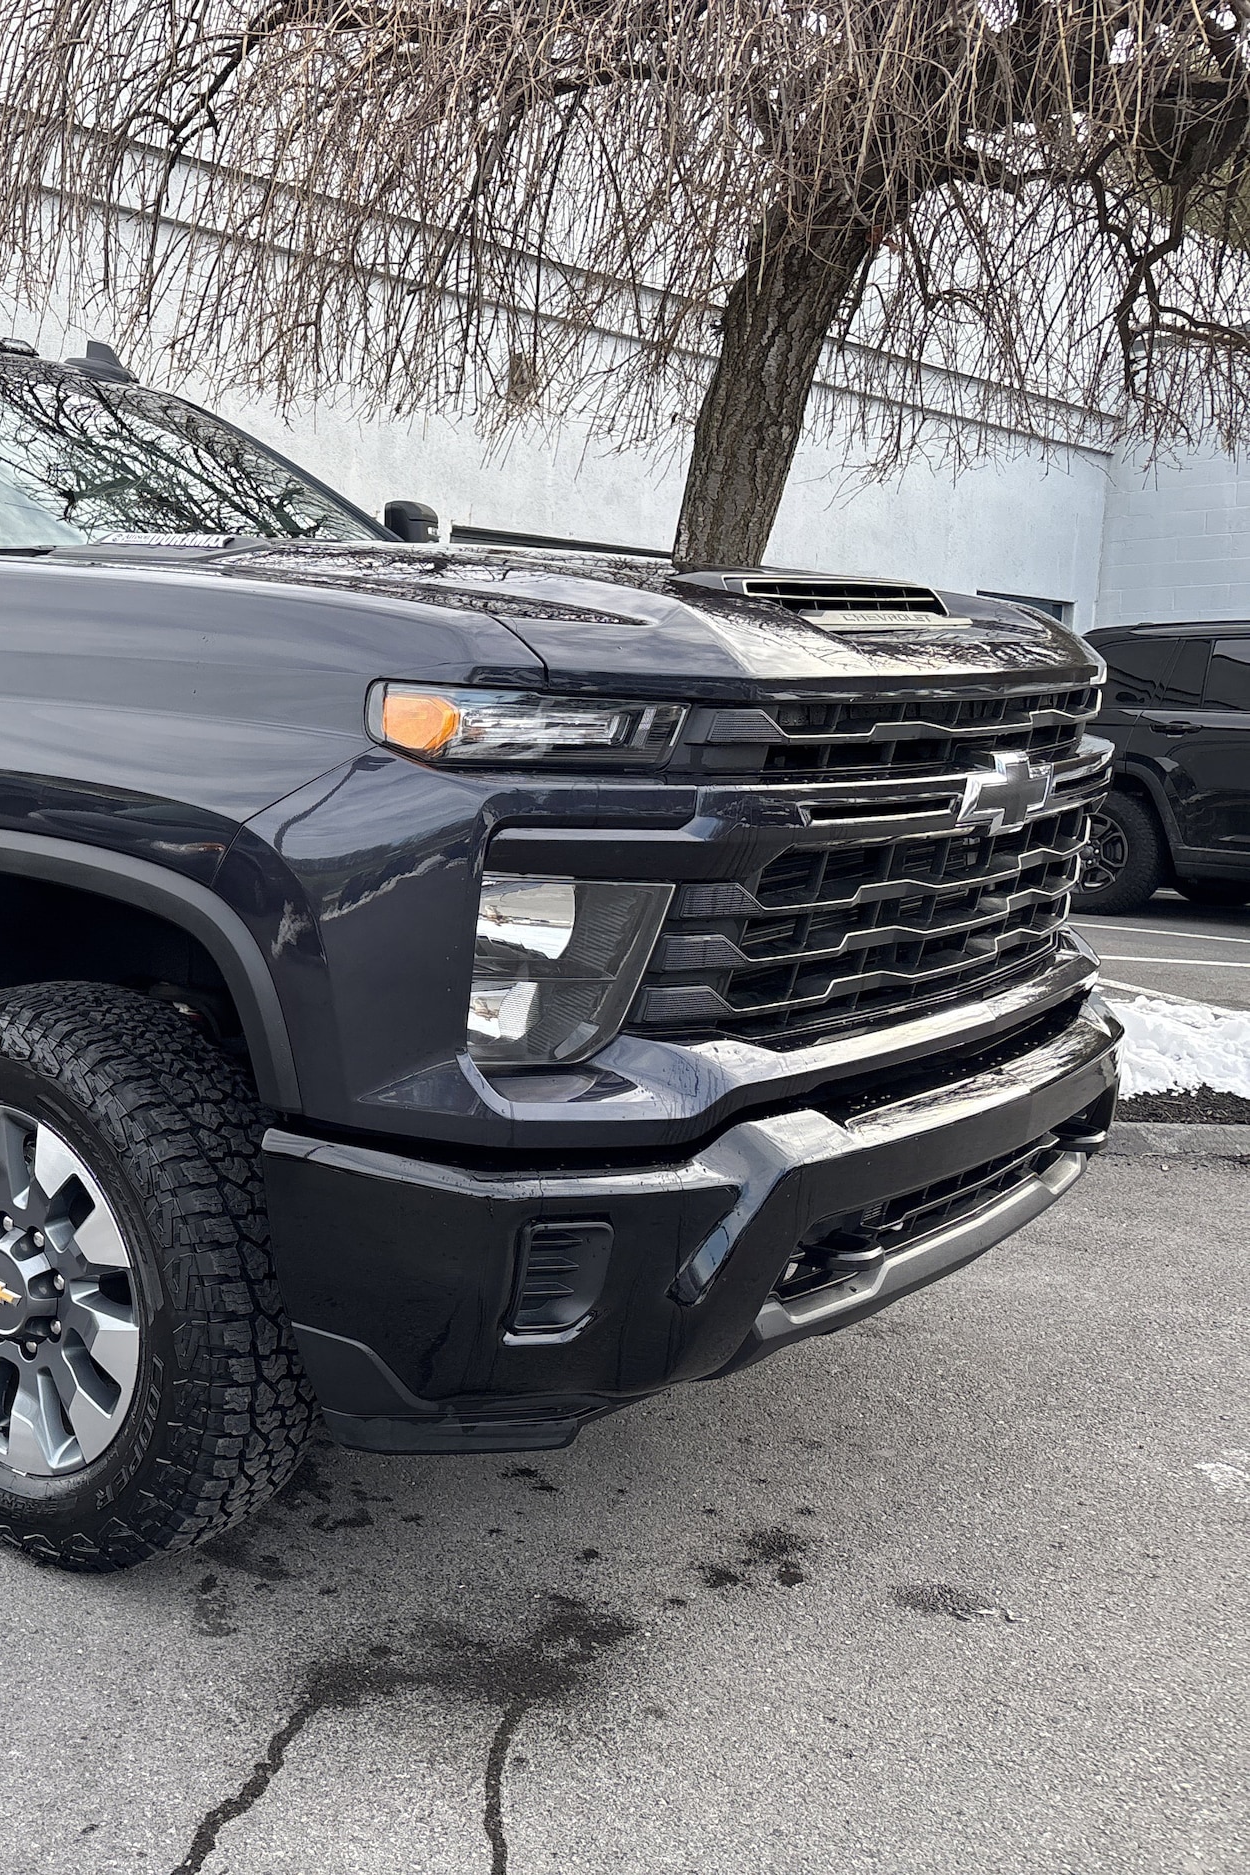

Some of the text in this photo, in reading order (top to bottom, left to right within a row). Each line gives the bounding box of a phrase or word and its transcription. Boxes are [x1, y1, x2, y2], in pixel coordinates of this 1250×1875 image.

[150, 533, 231, 548] DURAMAX
[840, 613, 932, 623] CHEVROLET
[95, 1353, 166, 1510] COOPER
